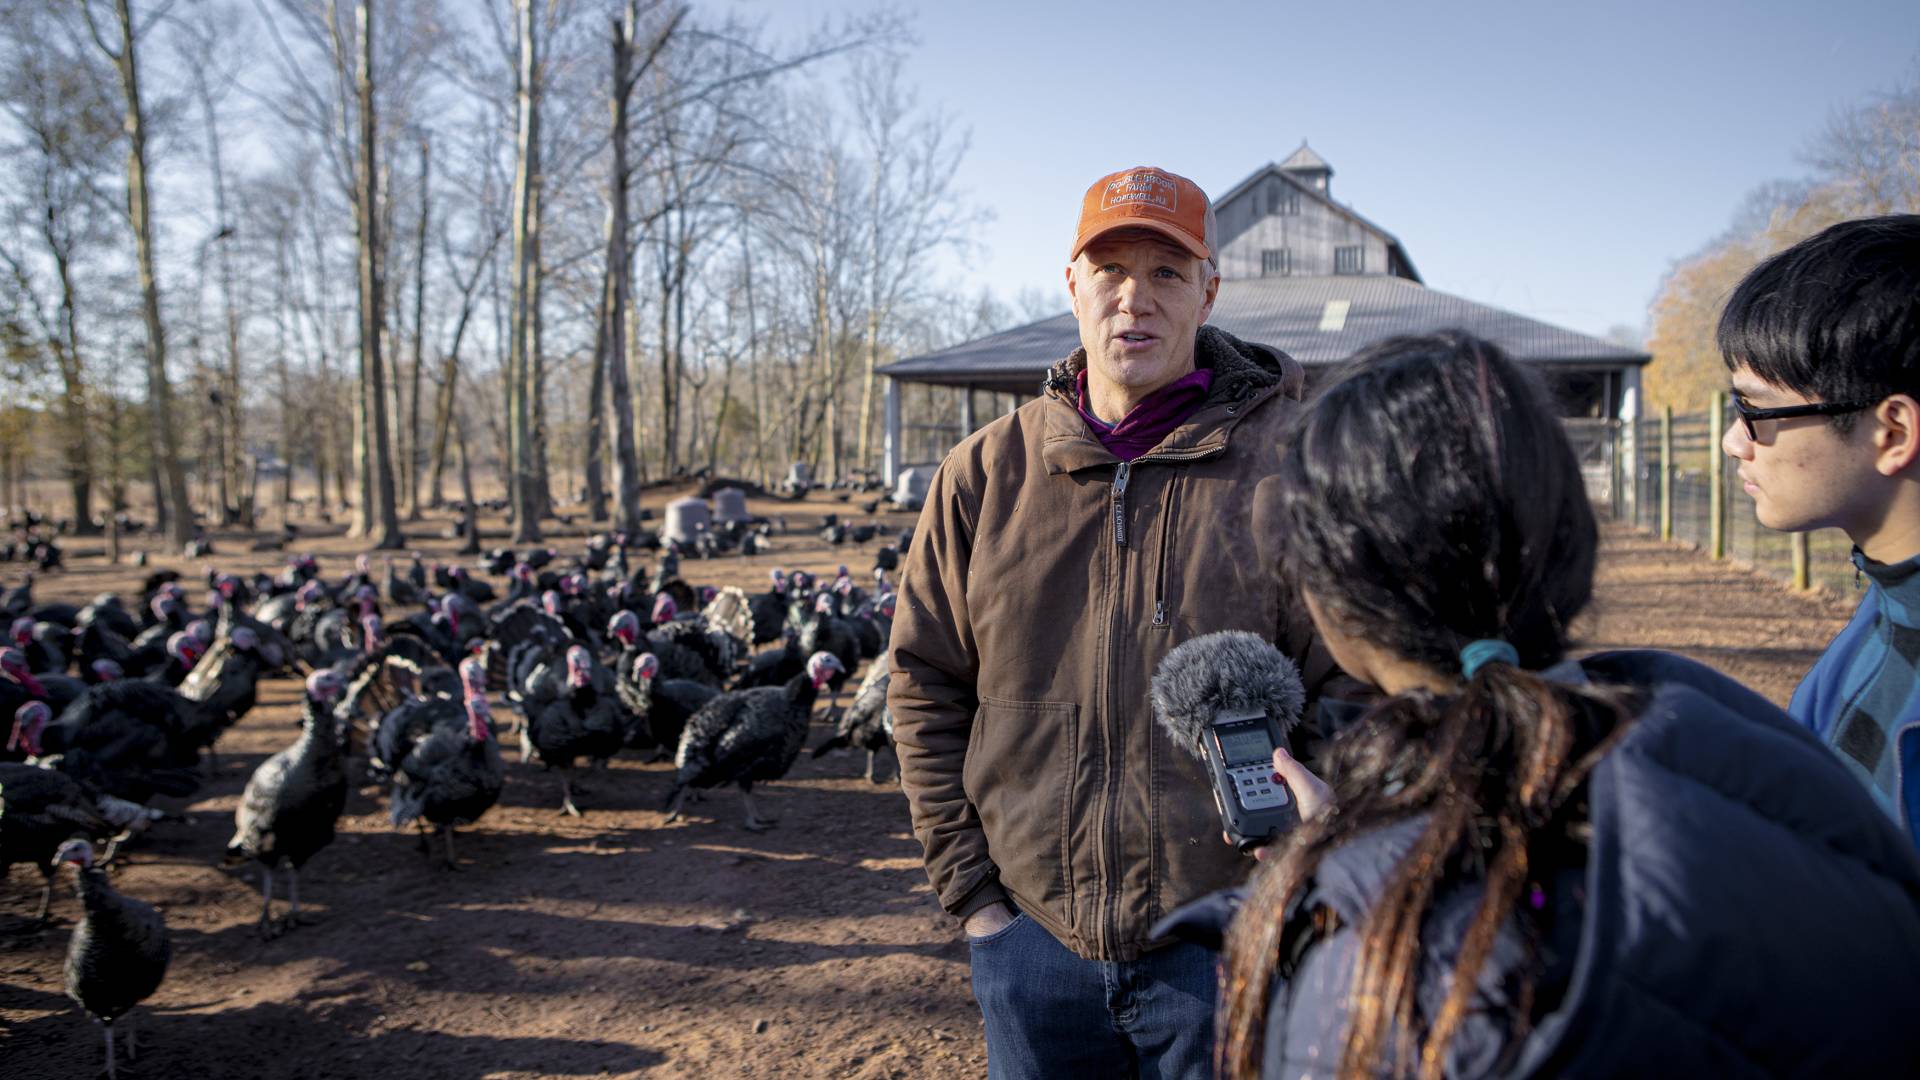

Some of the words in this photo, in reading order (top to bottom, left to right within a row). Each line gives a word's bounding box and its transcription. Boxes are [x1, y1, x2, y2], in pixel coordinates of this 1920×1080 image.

[1108, 174, 1141, 190] DOUBLE
[1143, 174, 1174, 190] BROOK
[1126, 182, 1152, 192] FARM
